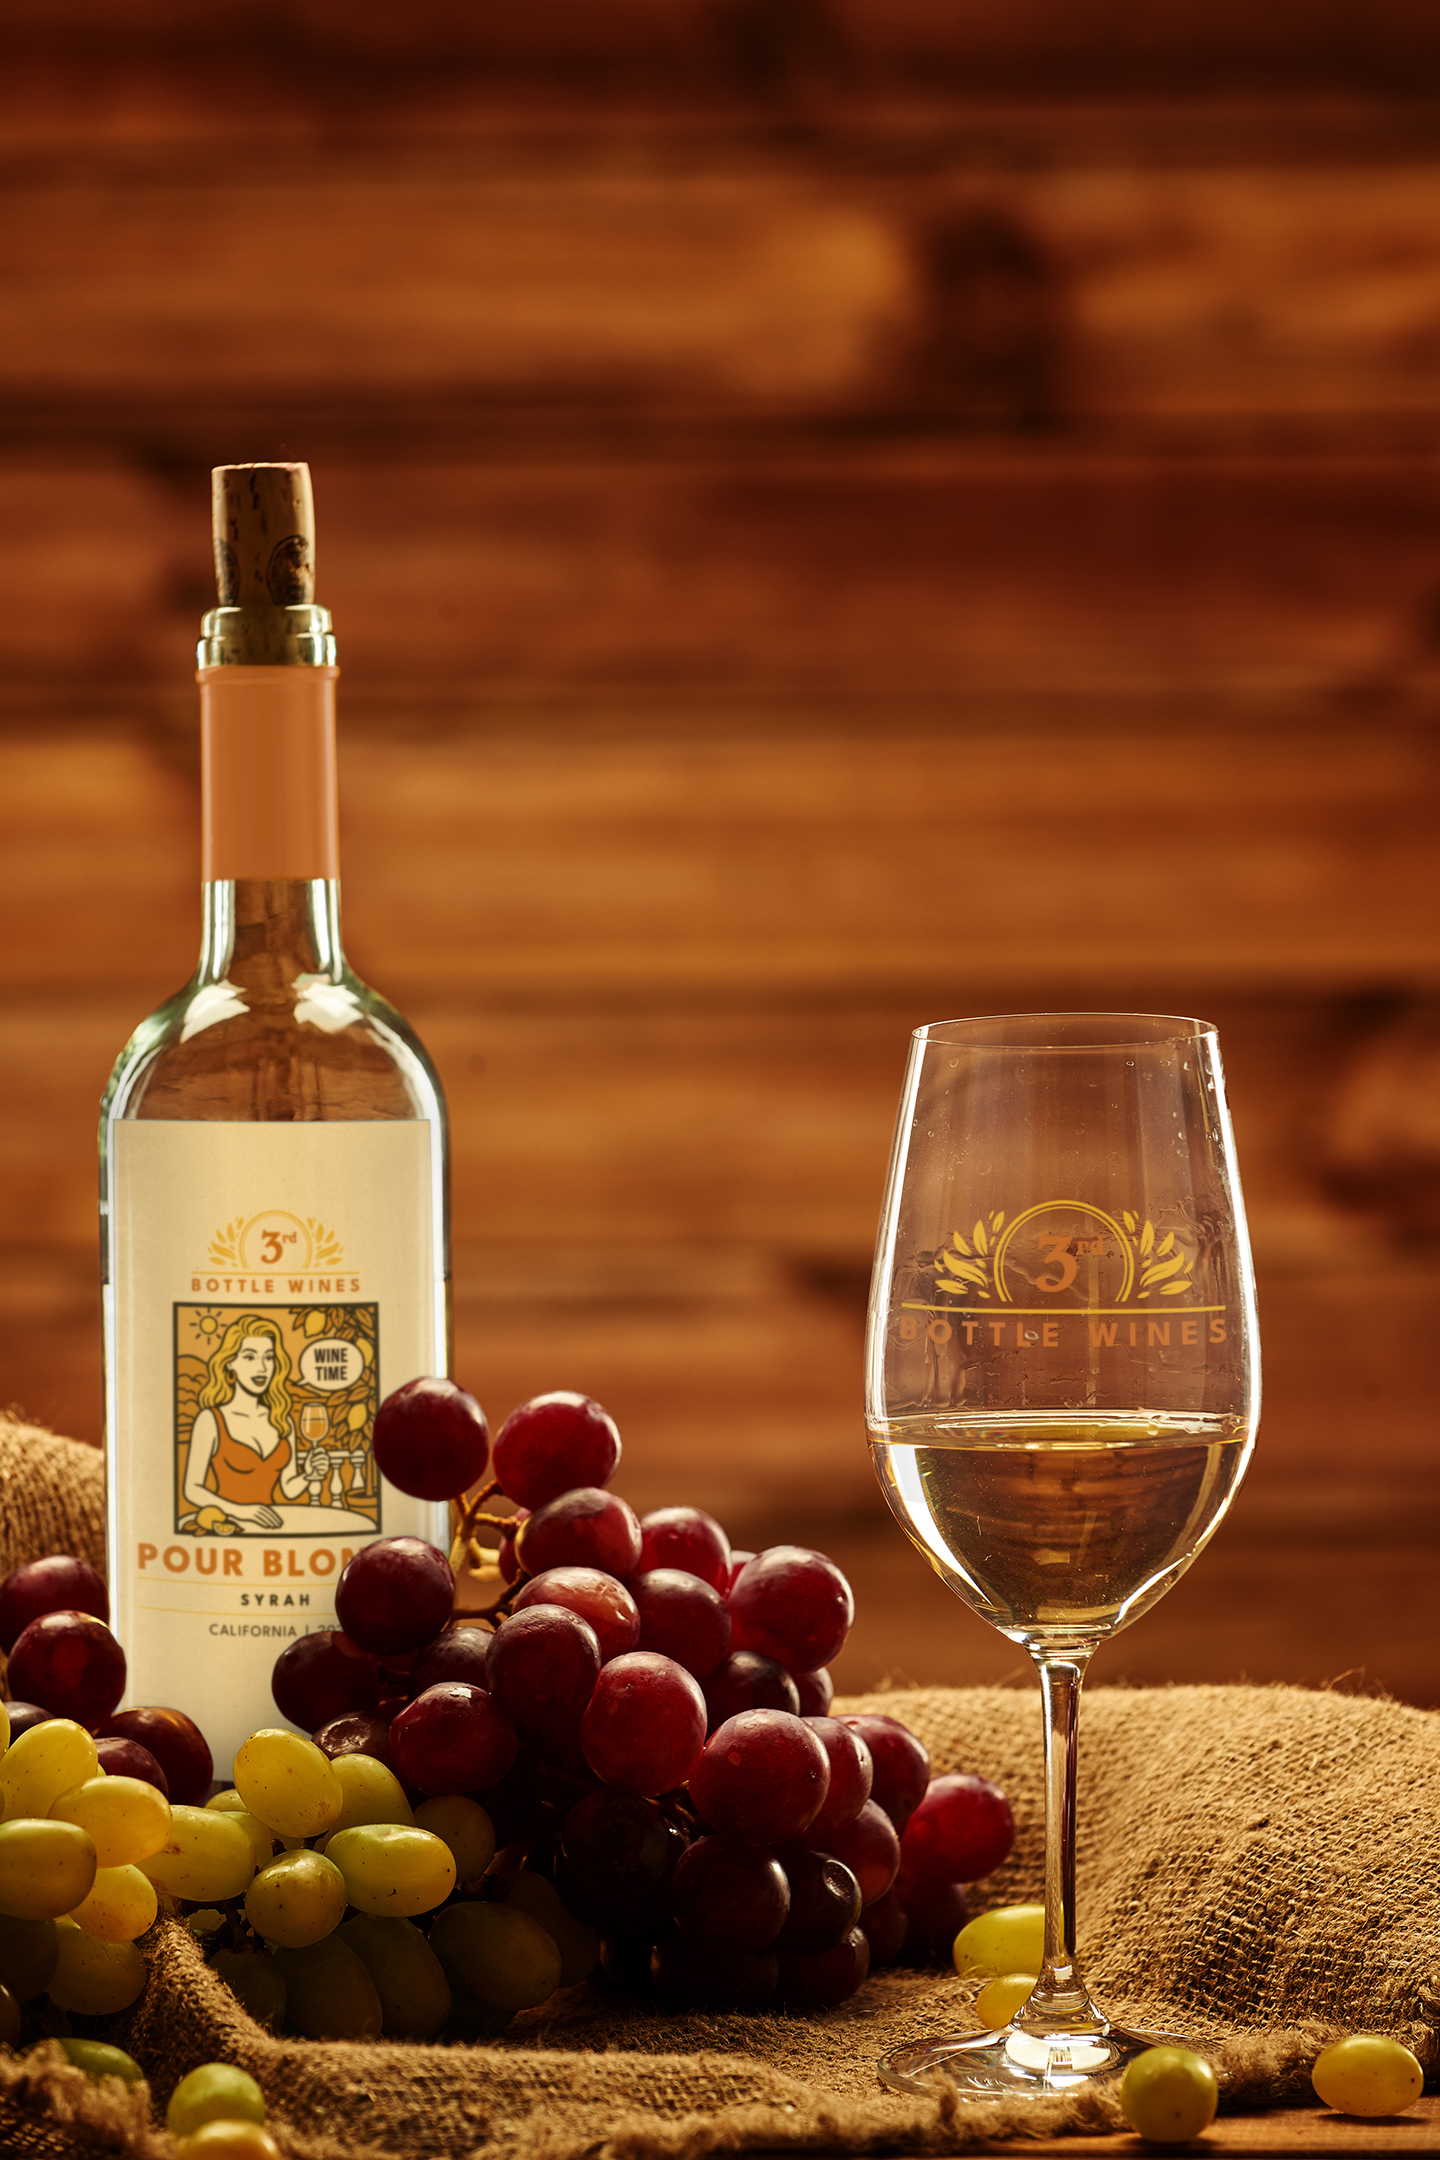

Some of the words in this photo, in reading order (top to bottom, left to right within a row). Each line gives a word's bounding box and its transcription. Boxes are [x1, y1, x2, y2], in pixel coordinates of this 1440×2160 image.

[260, 1229, 297, 1264] 3rd
[1035, 1231, 1104, 1293] 3rd
[191, 1278, 275, 1293] BOTTLE
[288, 1277, 361, 1293] WINES
[900, 1316, 1060, 1348] BOTTLE
[1088, 1318, 1228, 1348] WINES
[314, 1347, 349, 1363] WINE
[314, 1366, 348, 1382] TIME
[137, 1542, 244, 1577] POUR
[240, 1593, 310, 1607] SYRAH
[208, 1623, 297, 1637] CALIFORNIA
